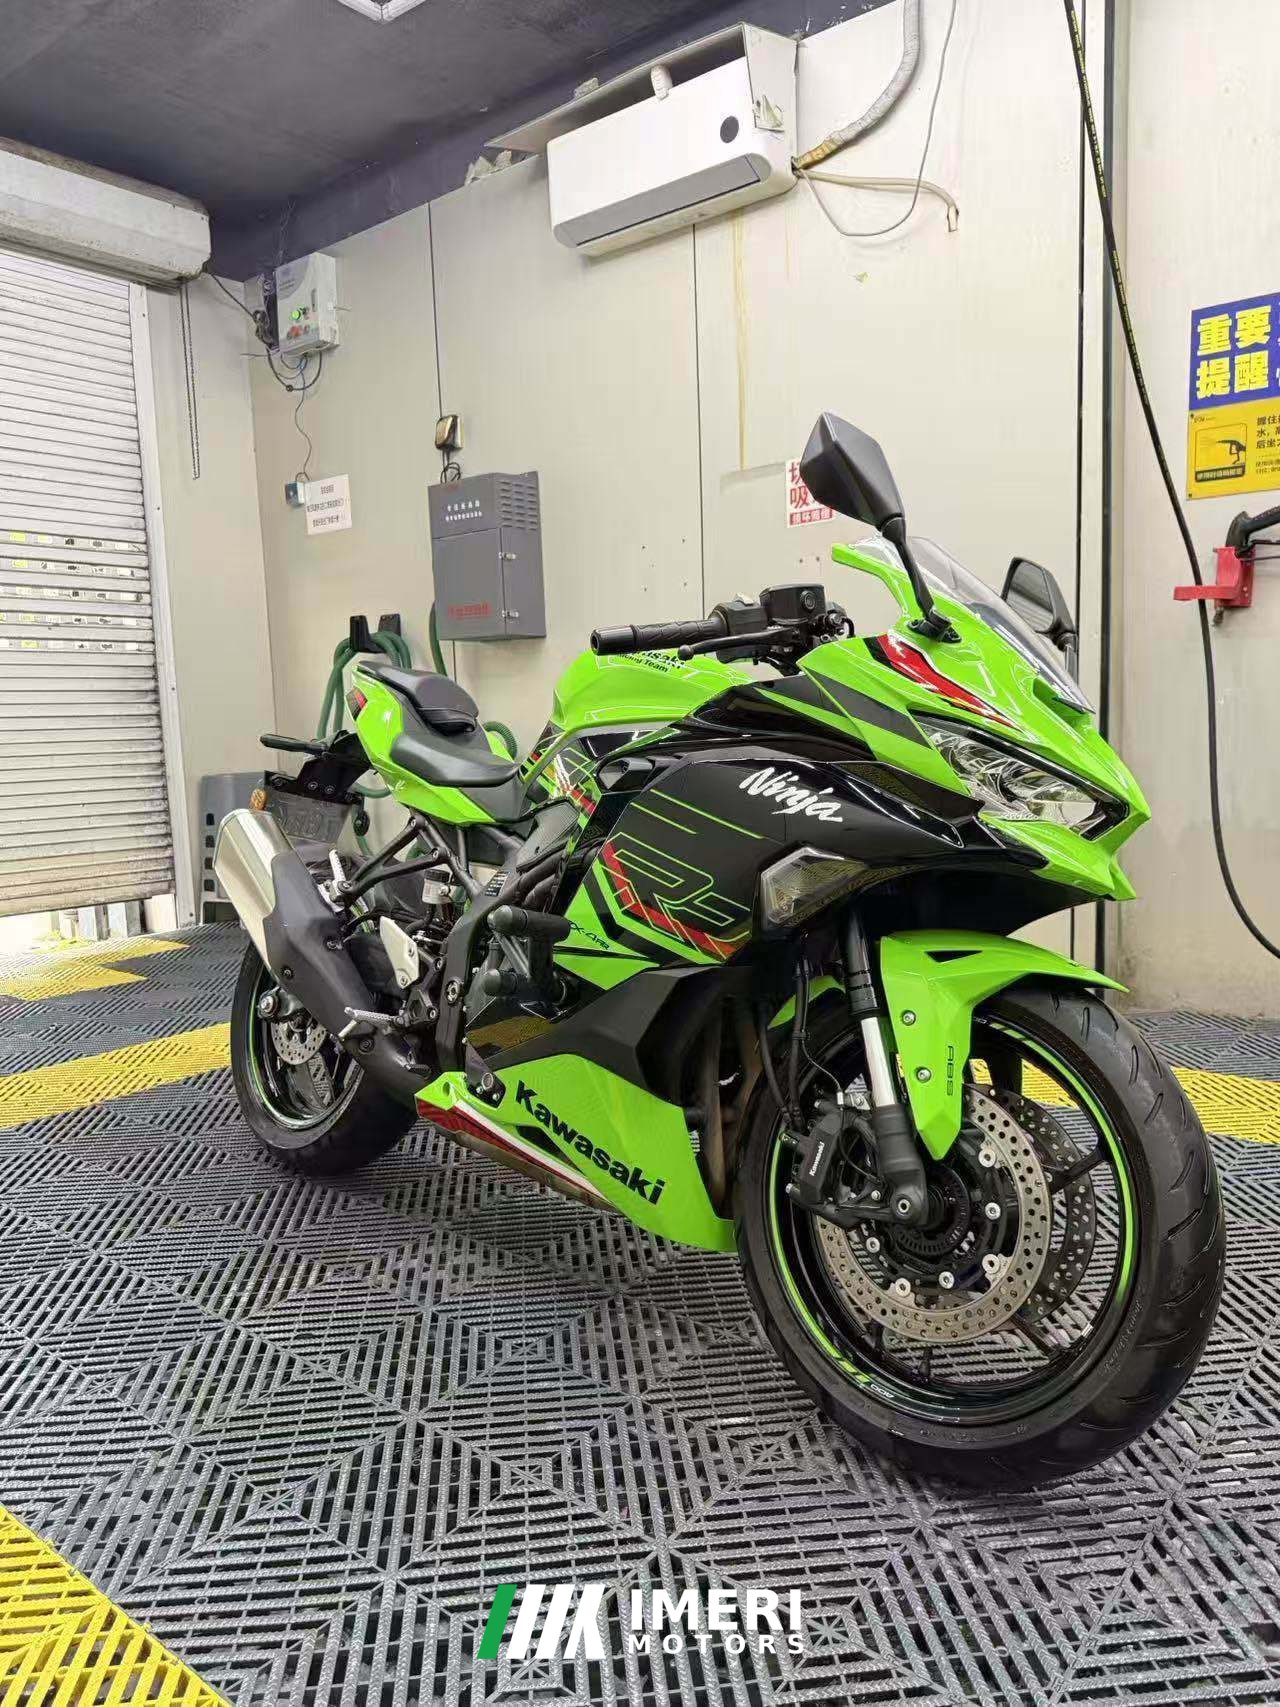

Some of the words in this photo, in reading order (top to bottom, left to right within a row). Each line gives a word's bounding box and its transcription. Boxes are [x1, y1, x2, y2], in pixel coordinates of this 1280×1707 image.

[1197, 305, 1272, 356] 重要
[1196, 350, 1269, 399] 提醒
[644, 659, 669, 672] Team
[739, 766, 843, 822] Ninja
[515, 1080, 666, 1205] Kawasaki
[809, 1141, 825, 1176] Kawasaki
